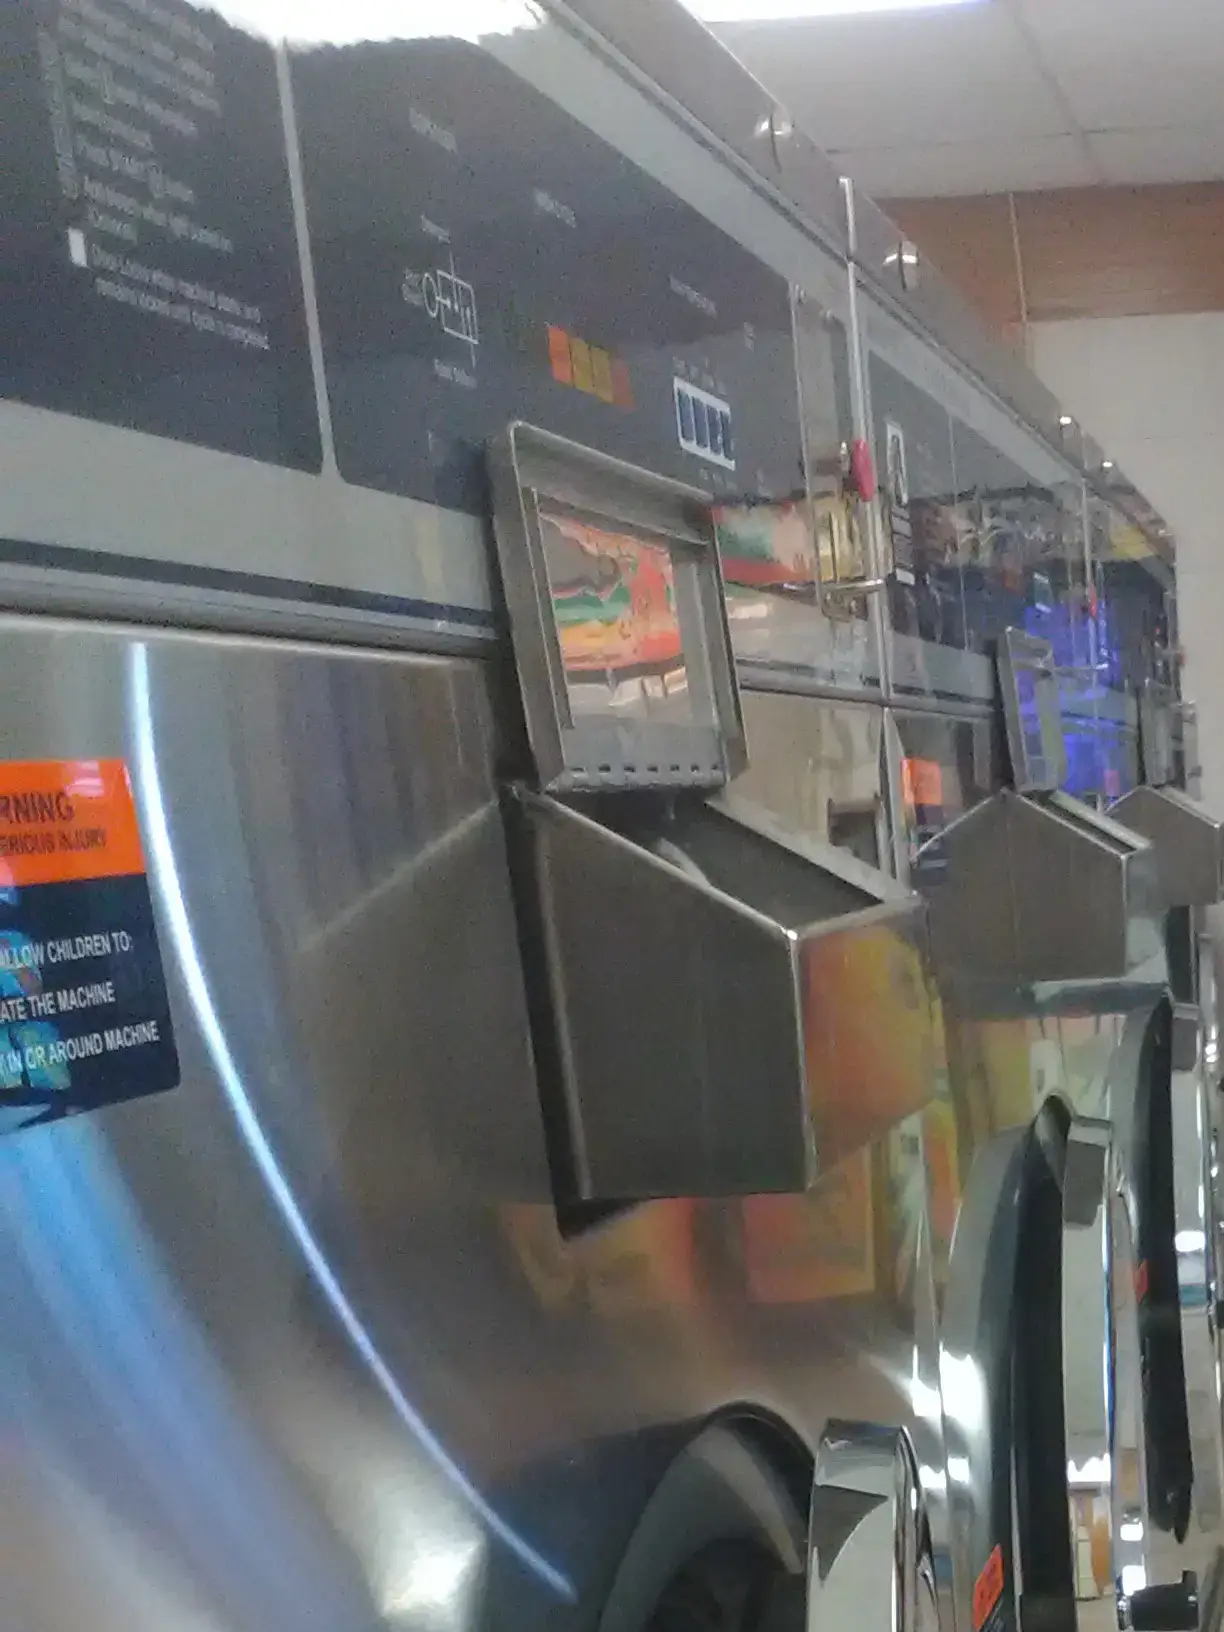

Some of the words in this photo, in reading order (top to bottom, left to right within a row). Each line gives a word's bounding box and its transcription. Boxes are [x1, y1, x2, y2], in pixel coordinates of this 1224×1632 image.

[47, 932, 111, 963] CHILDREN
[27, 992, 56, 1018] THE
[57, 981, 116, 1012] MACHINE
[7, 1049, 23, 1074] IN
[25, 1044, 46, 1070] OR
[48, 1032, 104, 1065] AROUND
[104, 1019, 161, 1053] MACHINE
